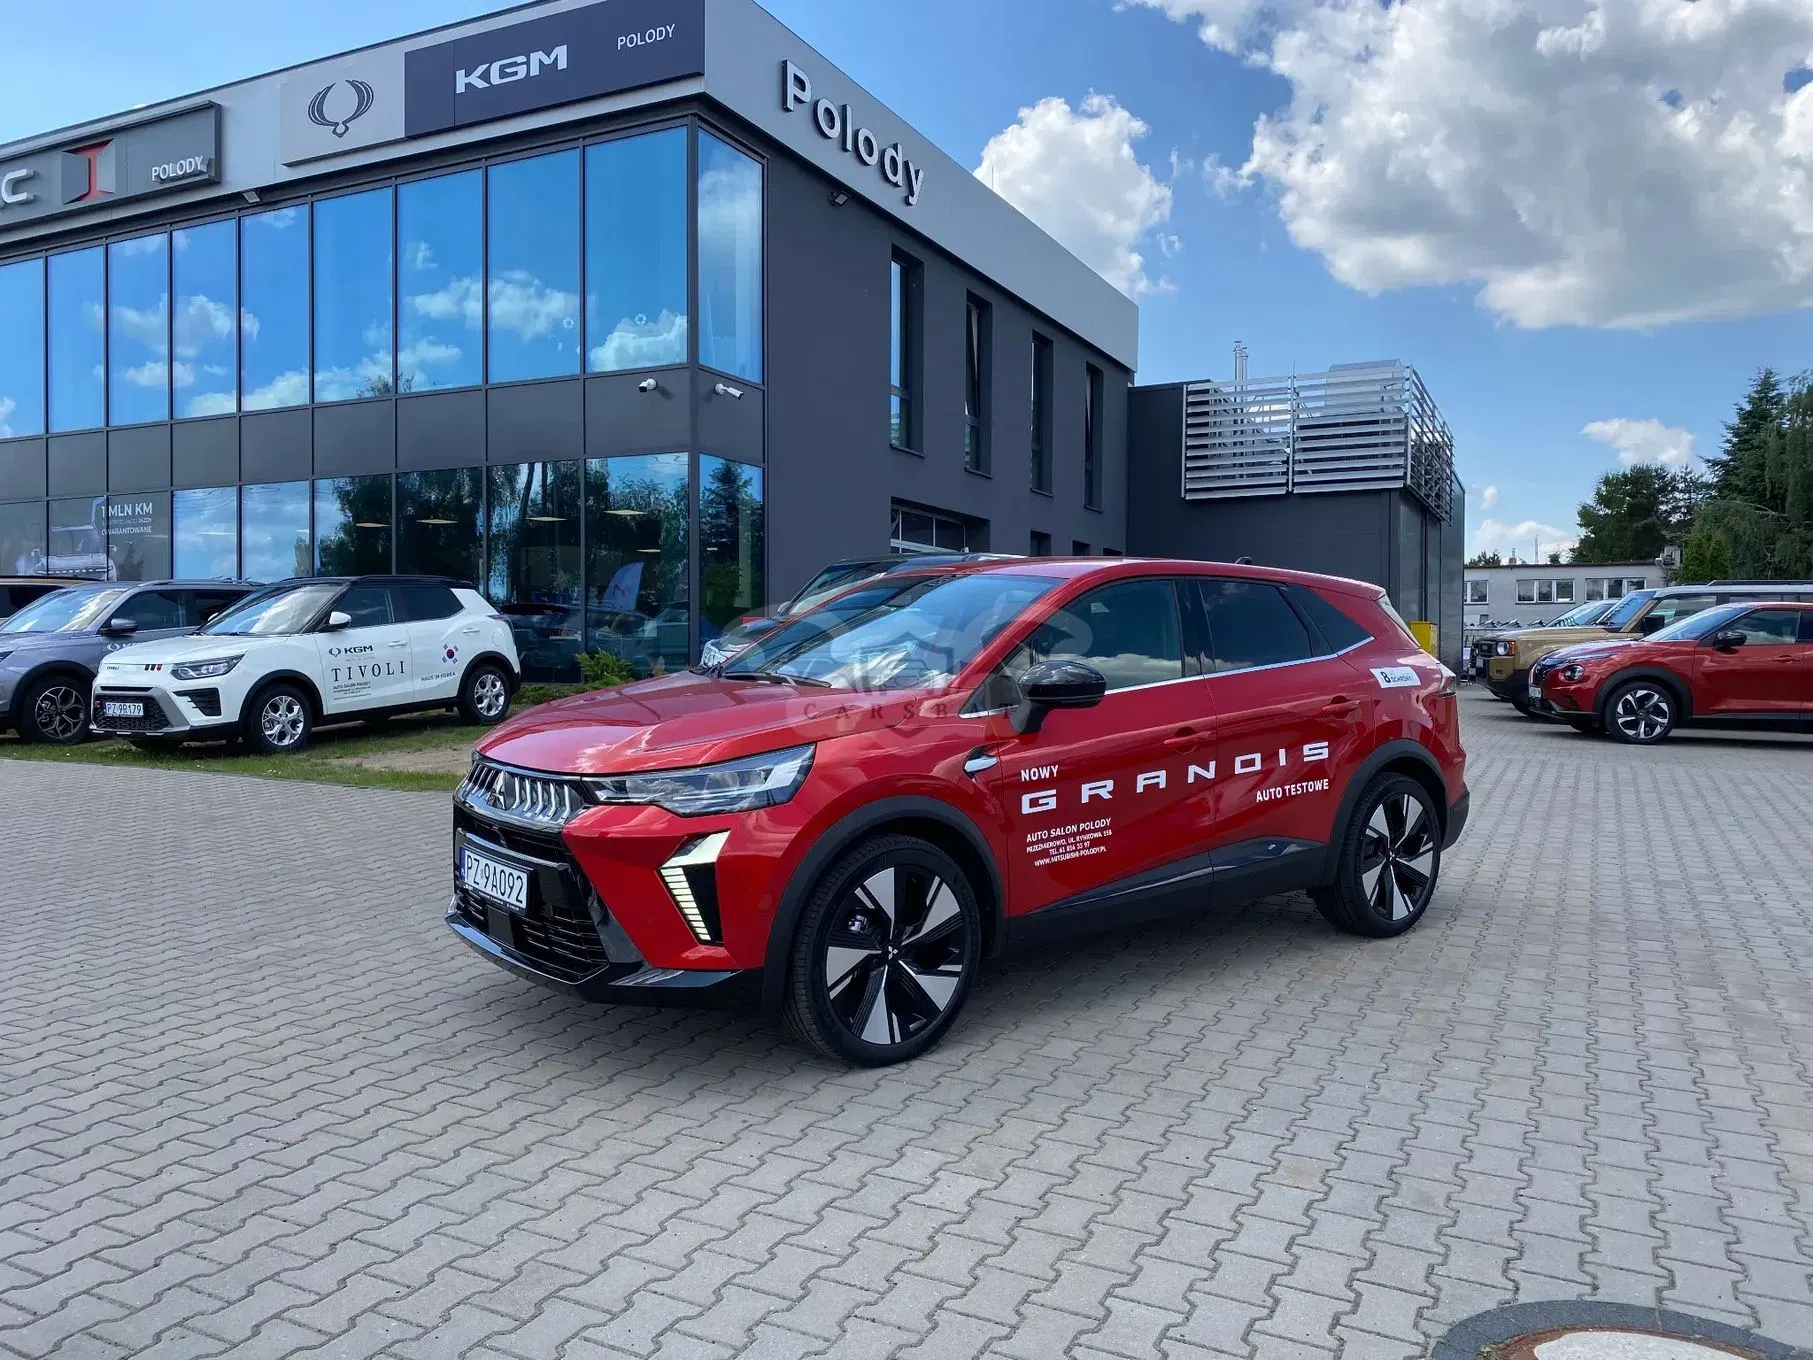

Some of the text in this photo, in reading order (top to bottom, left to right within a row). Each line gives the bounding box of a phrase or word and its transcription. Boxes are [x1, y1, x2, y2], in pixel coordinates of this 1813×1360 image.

[617, 24, 676, 50] POLODY
[456, 44, 567, 94] KGM
[781, 59, 925, 207] Polody
[152, 155, 204, 182] POLODY
[108, 503, 132, 517] MLN
[135, 502, 152, 515] KM
[344, 645, 373, 655] KGM
[331, 660, 405, 682] TIVOLI
[107, 703, 117, 714] PZ
[1021, 765, 1059, 782] NOWY
[1021, 742, 1329, 815] GRANDIS
[1256, 778, 1329, 803] AUTO TESTOWE
[1026, 817, 1112, 843] AUTO SALON POLODY
[467, 854, 524, 905] PZ 9A092
